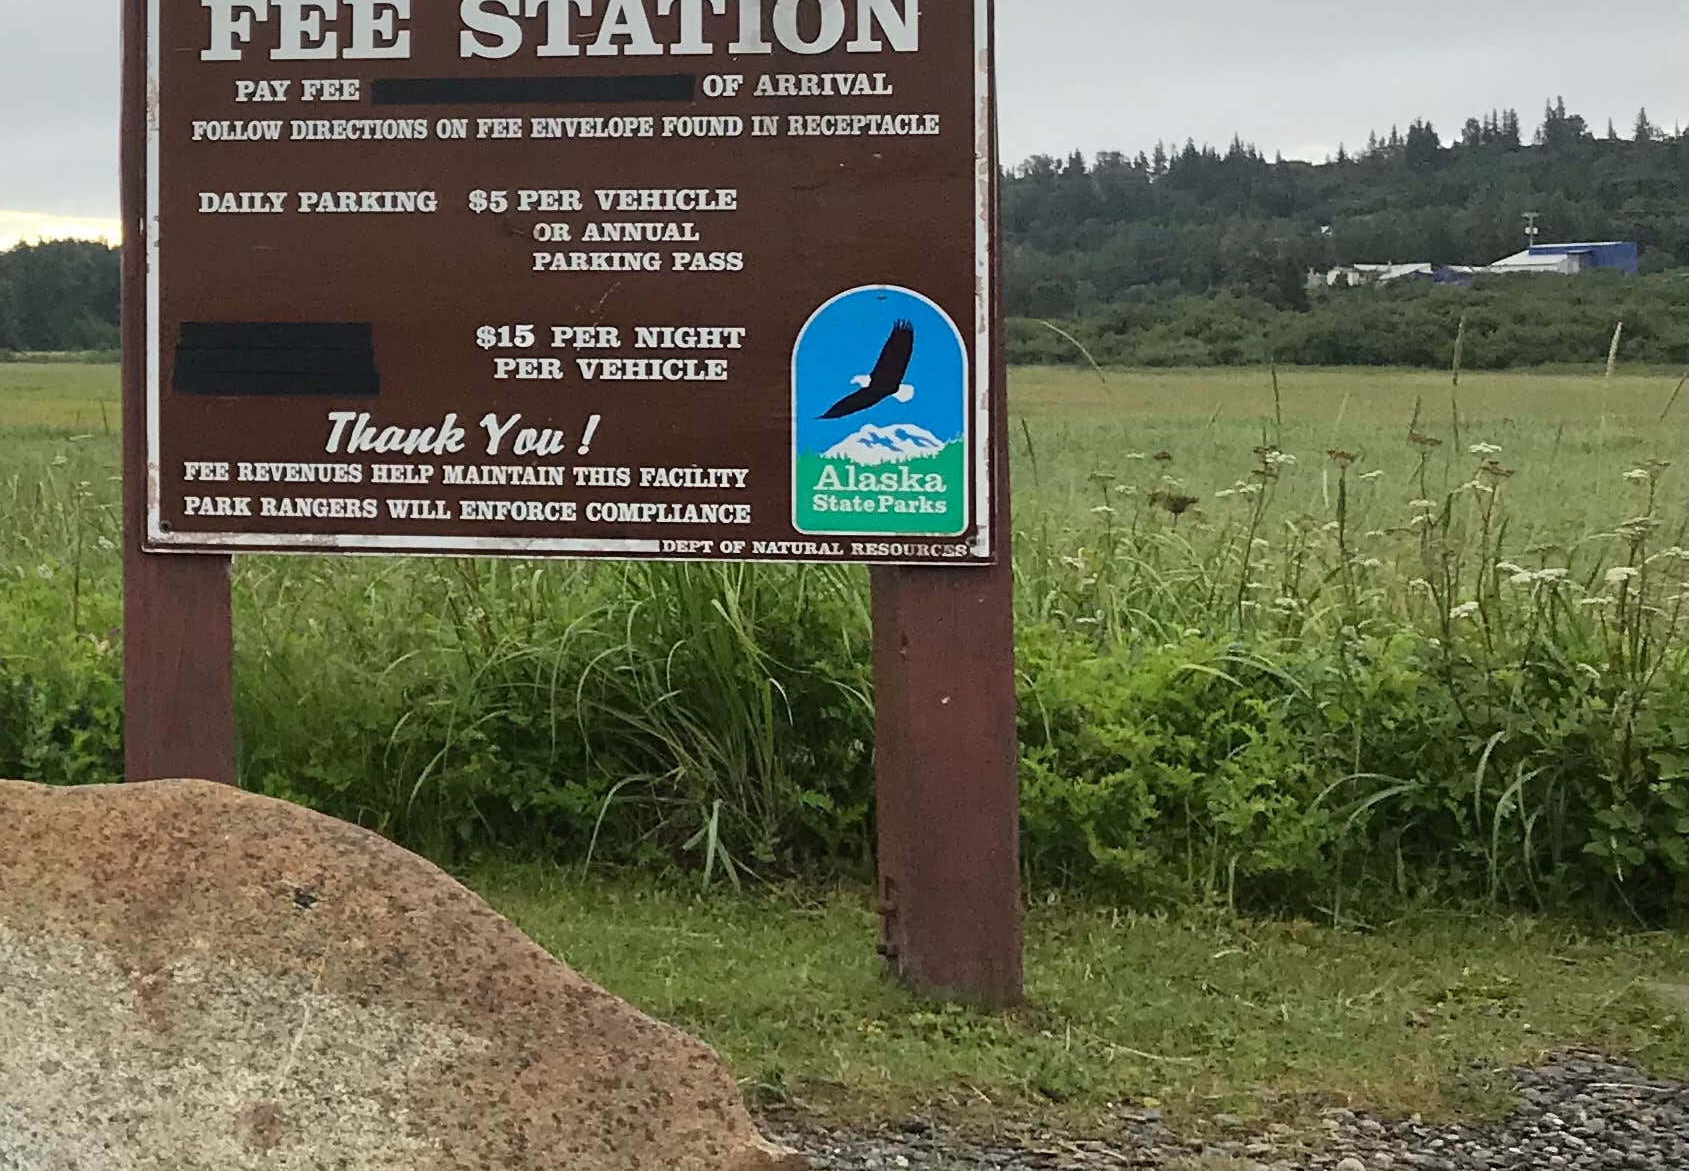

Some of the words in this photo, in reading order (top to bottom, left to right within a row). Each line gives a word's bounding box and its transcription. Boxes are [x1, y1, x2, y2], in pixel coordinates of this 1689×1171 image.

[236, 80, 290, 101] PAY
[302, 80, 359, 100] FEE
[703, 75, 743, 96] OF
[754, 73, 892, 95] ARRIVAL
[192, 121, 283, 140] FOLLOW
[291, 119, 427, 139] DIRECTIONS
[437, 119, 468, 138] ON
[477, 119, 522, 138] FEE
[531, 117, 653, 137] ENVELOPE
[662, 117, 742, 136] FOUND
[752, 116, 779, 135] IN
[788, 115, 939, 135] RECEPTACLE
[199, 192, 287, 212] DAILY
[298, 191, 437, 212] PARKING
[469, 190, 507, 213] $5
[518, 190, 582, 210] PER
[595, 190, 736, 210] VEHICLE
[534, 223, 571, 241] OR
[582, 223, 699, 241] ANNUAL
[533, 252, 662, 270] PARKING
[672, 252, 743, 270] PASS
[477, 325, 534, 349] $15
[551, 327, 621, 348] PER
[635, 327, 745, 348] NIGHT
[494, 358, 563, 379] PER
[576, 359, 727, 380] VEHICLE
[326, 412, 465, 455] Thank
[480, 414, 564, 455] You
[184, 462, 229, 480] FEE
[238, 463, 362, 482] REVENUES
[371, 464, 434, 483] HELP
[443, 465, 565, 485] MAINTAIN
[573, 467, 630, 486] THIS
[640, 467, 748, 487] FACILITY
[813, 465, 946, 492] Alaska
[184, 497, 251, 515] PARK
[261, 498, 377, 518] RANGERS
[387, 500, 451, 519] WILL
[460, 501, 576, 521] ENFORCE
[586, 503, 750, 523] COMPLIANCE
[813, 494, 875, 512] State
[878, 495, 946, 513] Parks
[662, 540, 713, 553] DEPT
[720, 540, 745, 554] OF
[752, 541, 844, 556] NATURAL
[851, 542, 967, 557] RESOURCES
